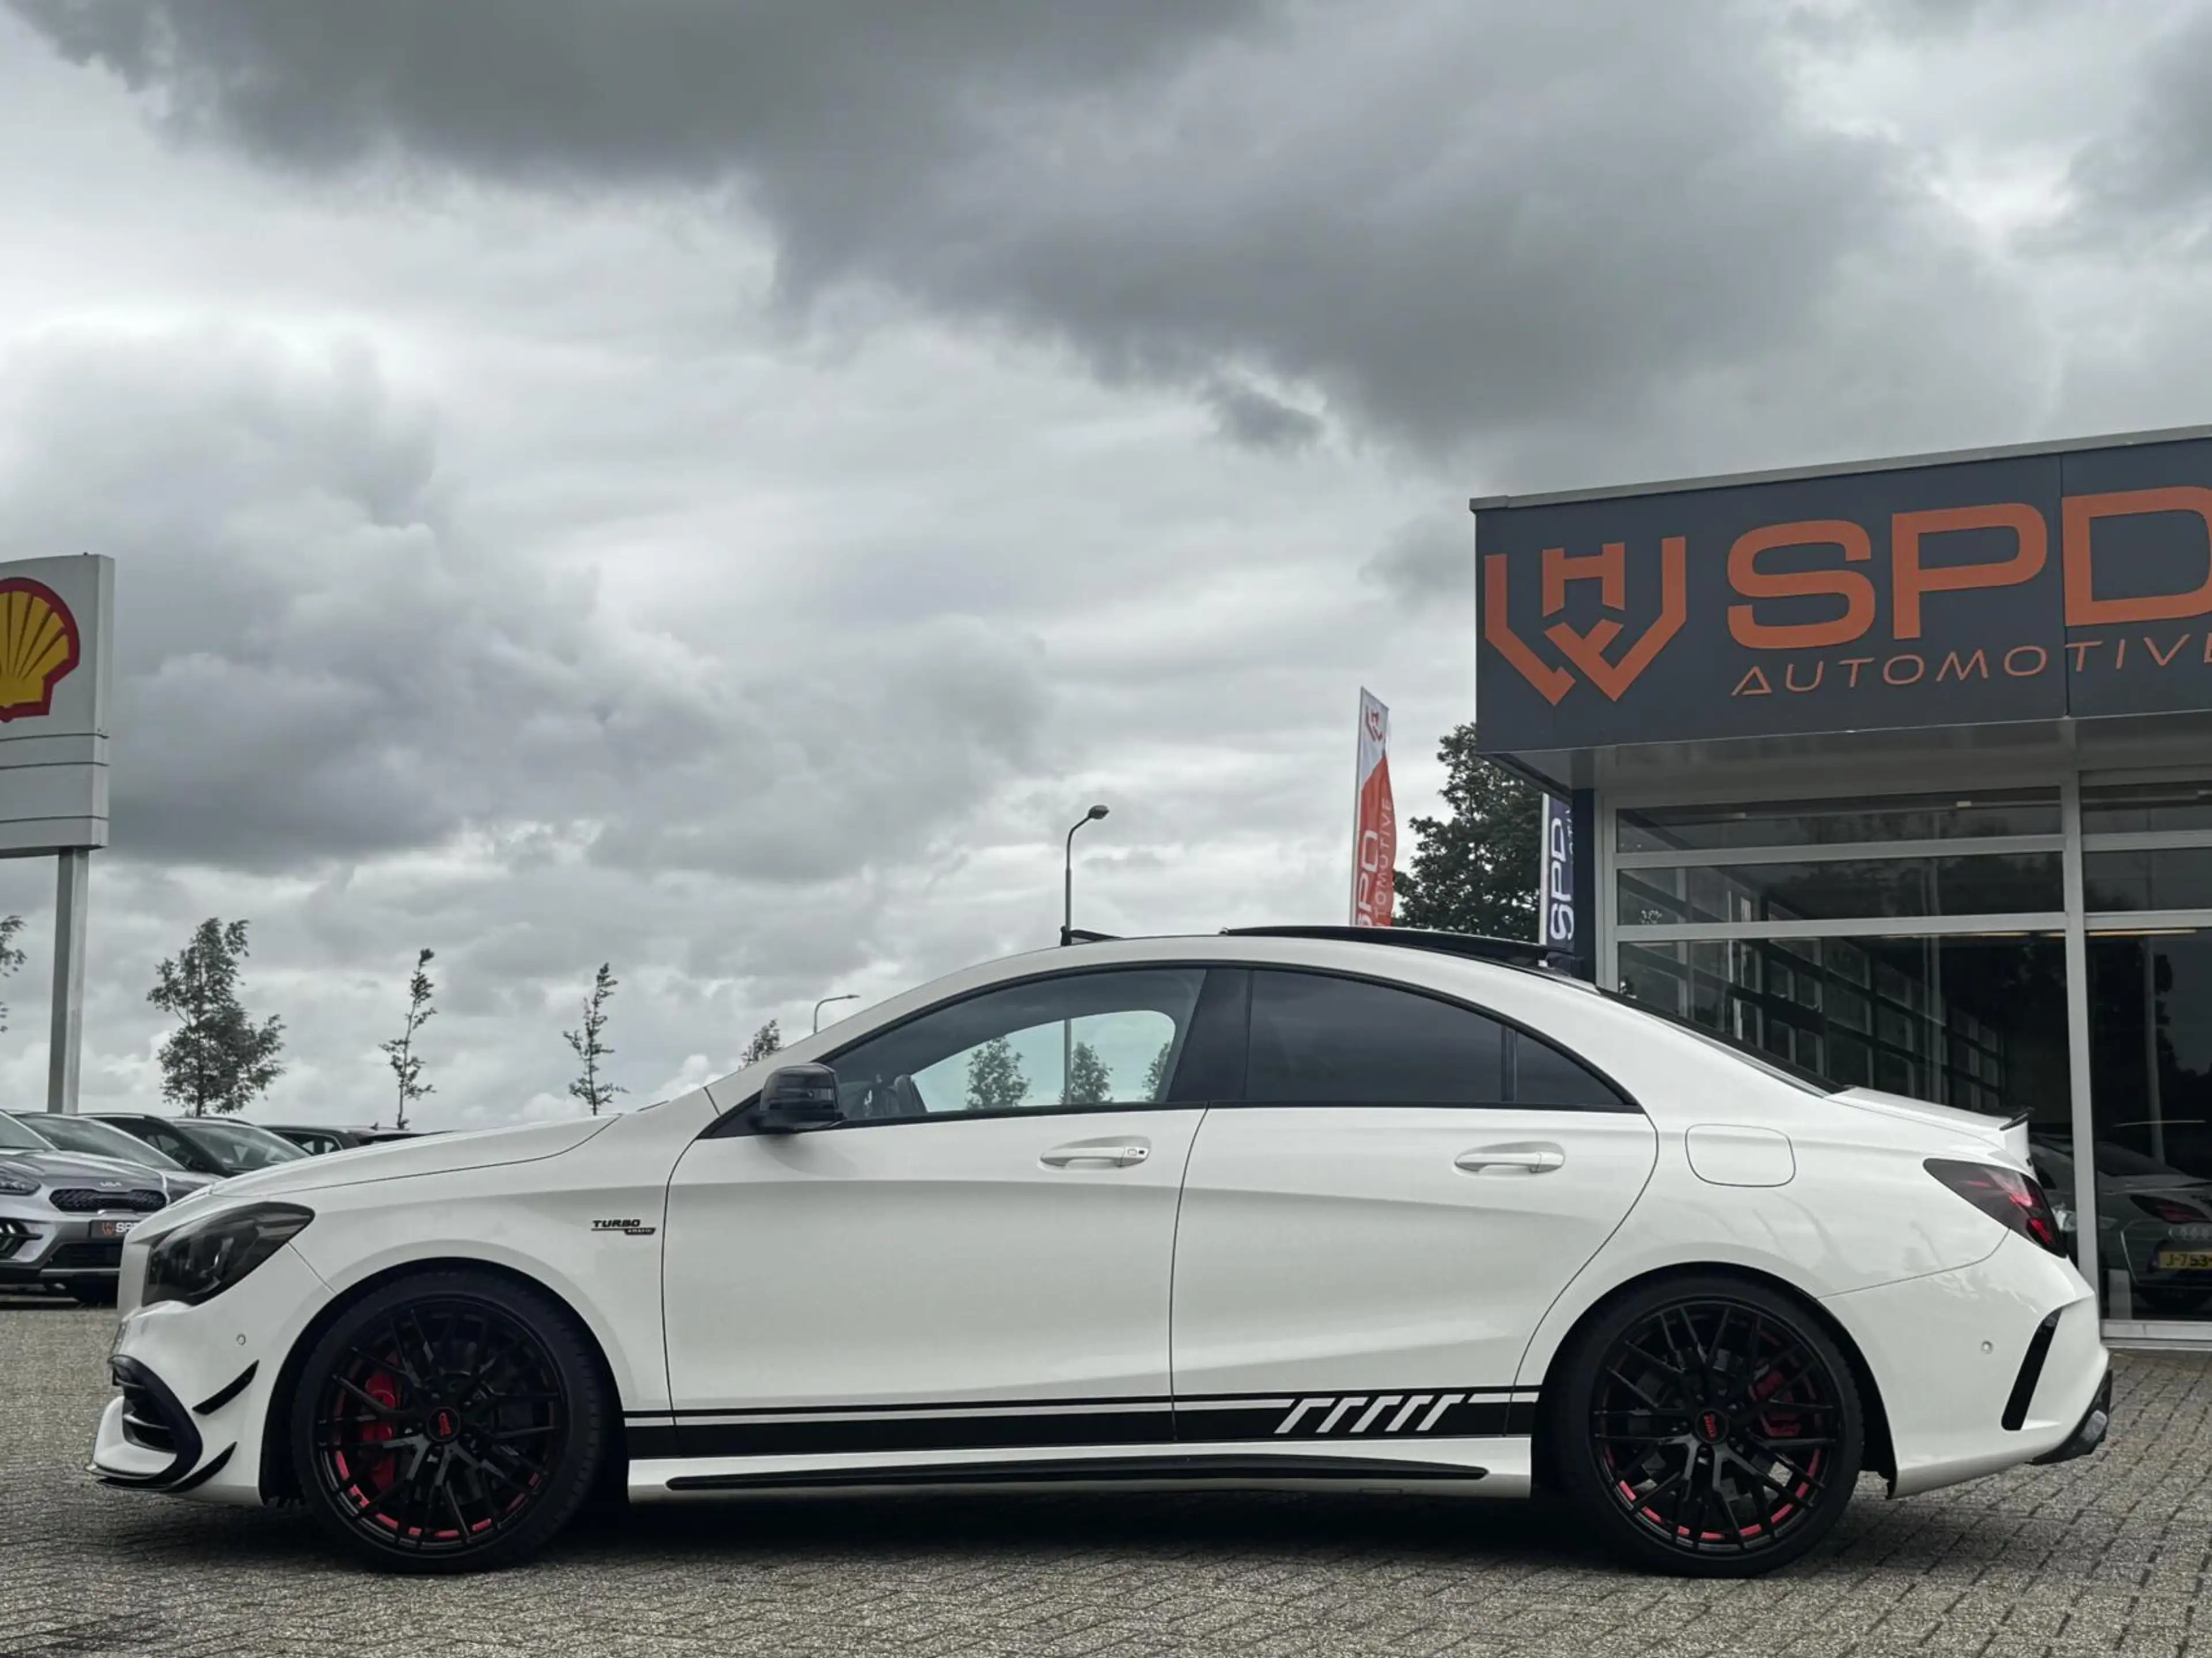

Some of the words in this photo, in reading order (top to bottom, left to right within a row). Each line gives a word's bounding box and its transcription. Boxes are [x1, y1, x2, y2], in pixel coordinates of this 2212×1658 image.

[1728, 486, 2212, 650] SPD
[1732, 633, 2212, 696] AUTOMOTIV
[1374, 798, 1393, 927] TOMOTIVE
[1550, 817, 1574, 940] SPD
[592, 1219, 641, 1227] TURBO
